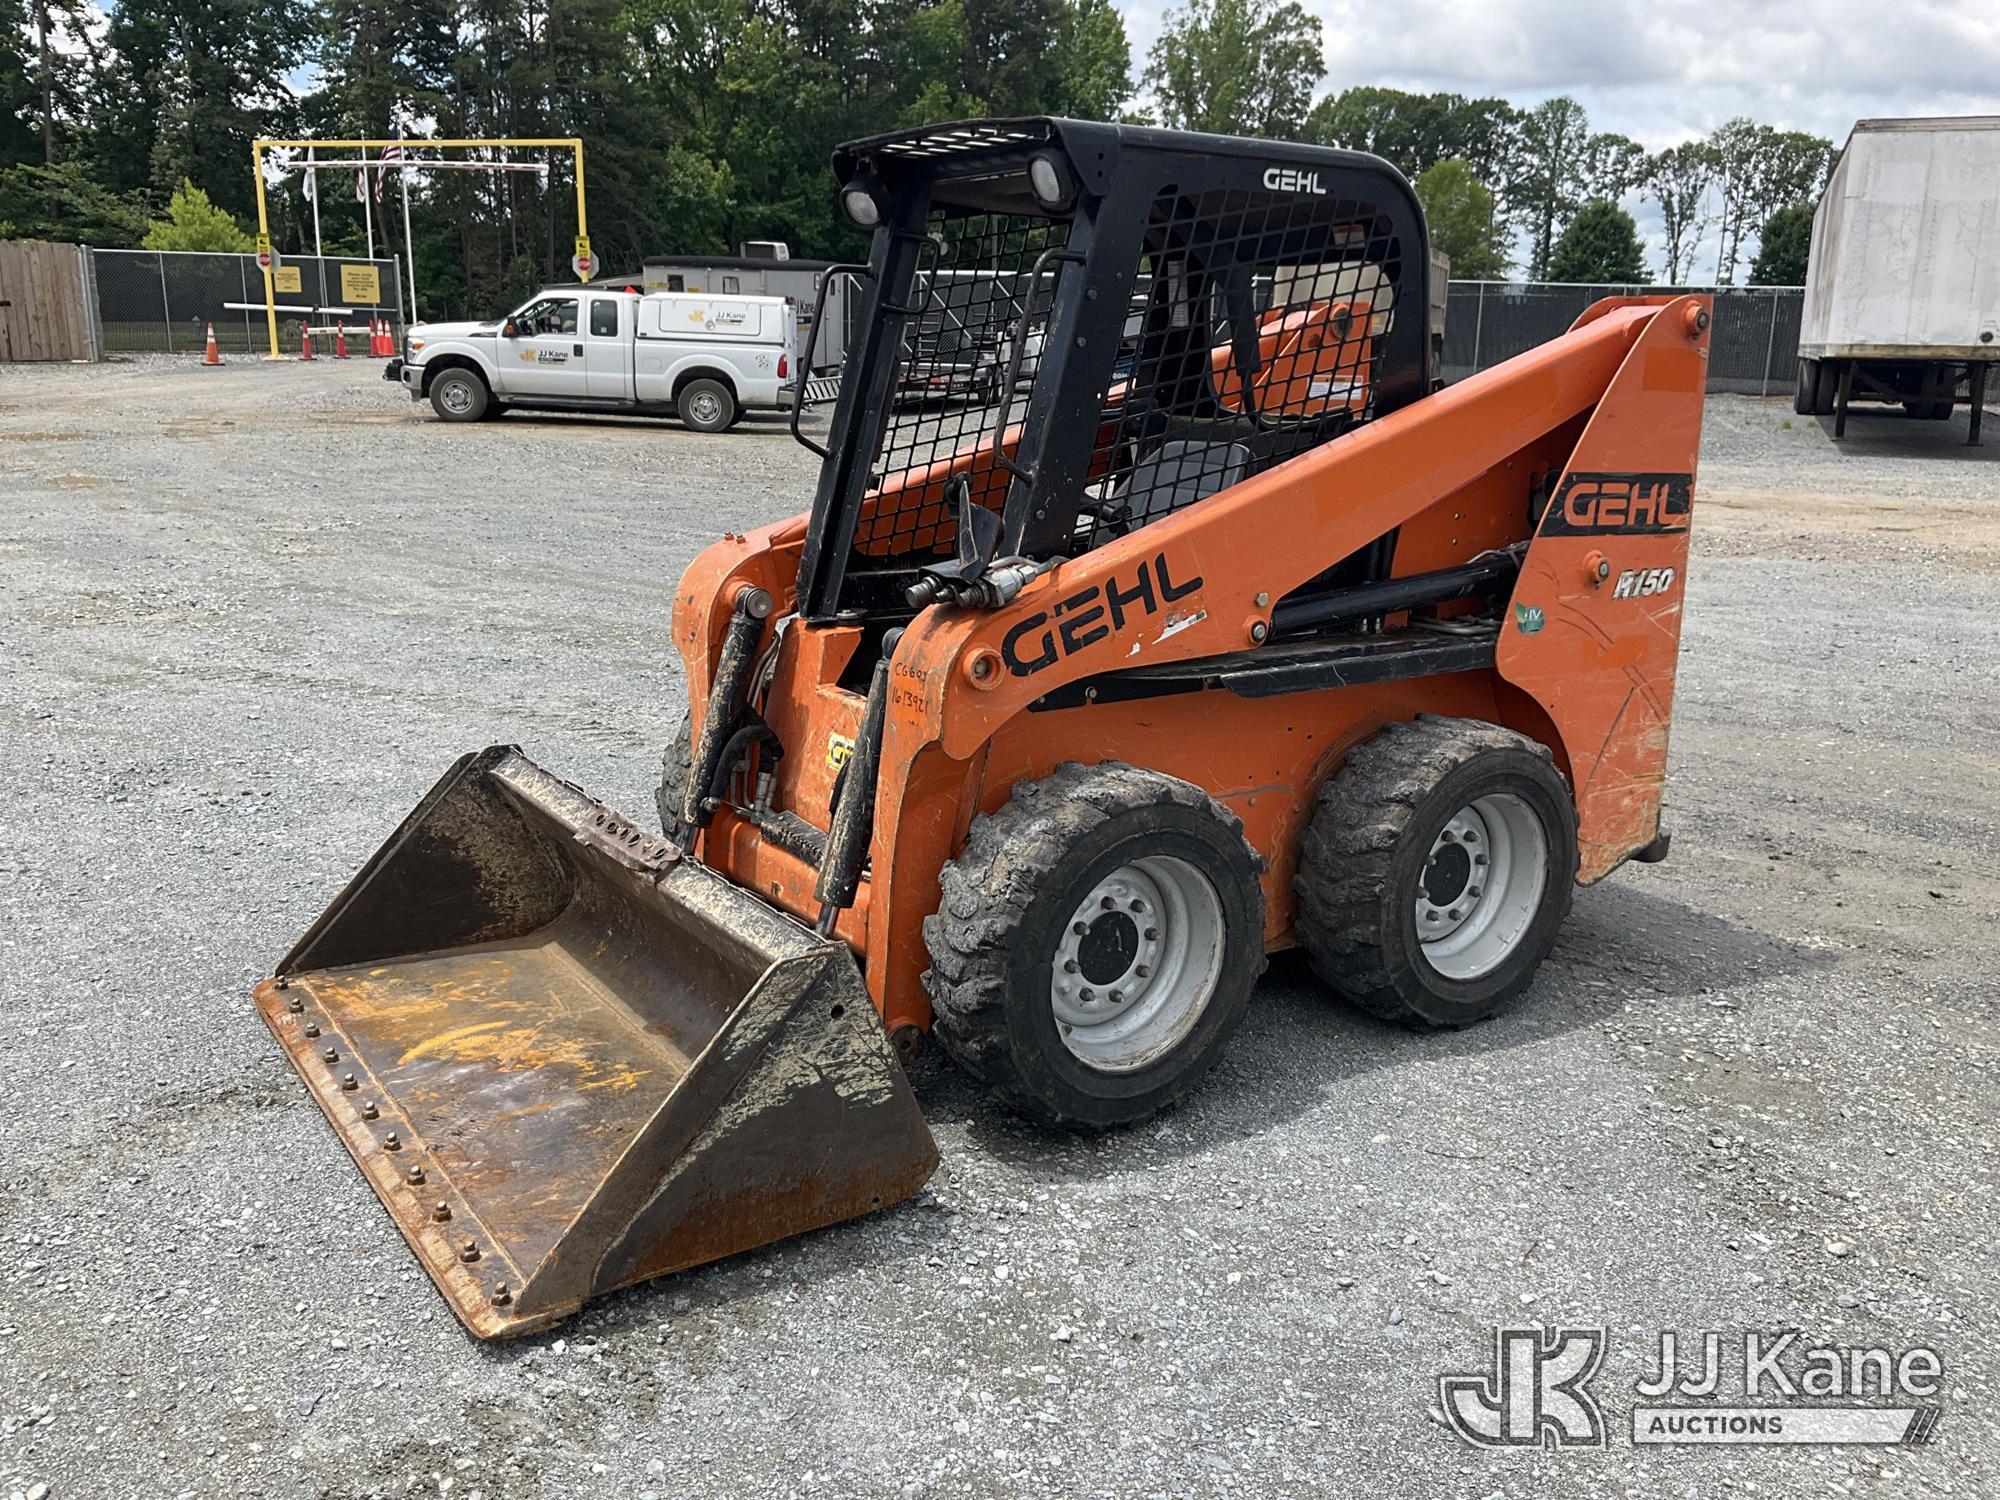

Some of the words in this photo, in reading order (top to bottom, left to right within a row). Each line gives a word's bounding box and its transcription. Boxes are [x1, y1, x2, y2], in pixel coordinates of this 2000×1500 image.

[1263, 168, 1326, 195] GEHL
[726, 311, 746, 320] Kane
[548, 350, 568, 359] Kane
[1563, 482, 1688, 527] GEHL
[1611, 567, 1676, 600] R150
[1001, 552, 1204, 677] GEHL
